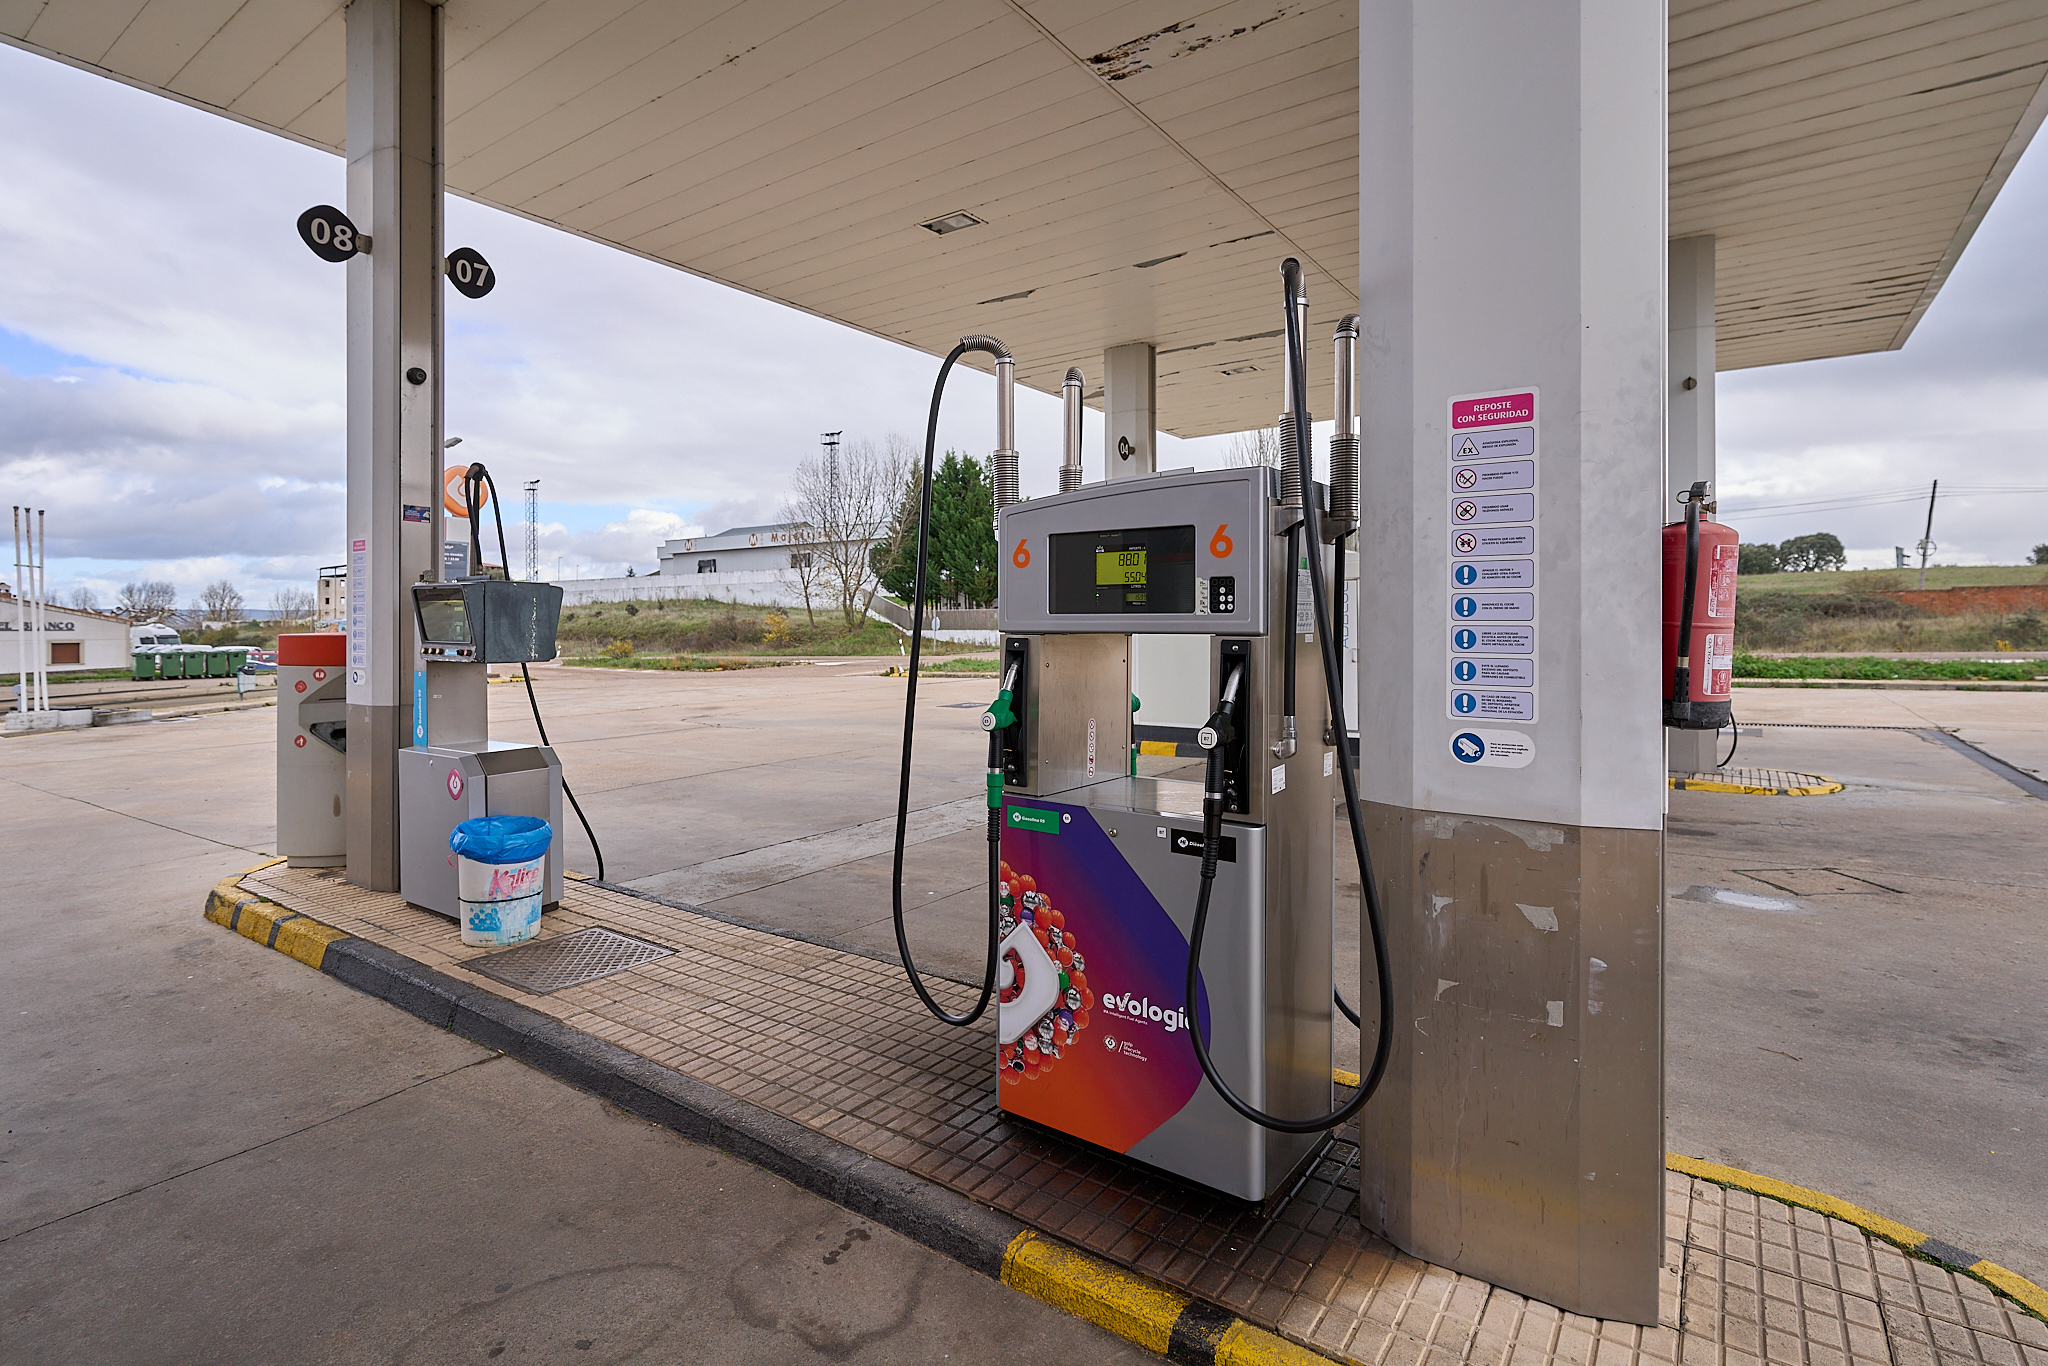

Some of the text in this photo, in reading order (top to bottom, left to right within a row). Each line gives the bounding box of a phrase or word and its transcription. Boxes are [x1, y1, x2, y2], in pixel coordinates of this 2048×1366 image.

[311, 218, 353, 252] 08
[456, 259, 489, 287] 07
[1458, 409, 1529, 423] CON SEGURIDAD
[1474, 401, 1512, 412] REPOSTE
[1013, 539, 1030, 568] 6
[1210, 524, 1234, 558] 6
